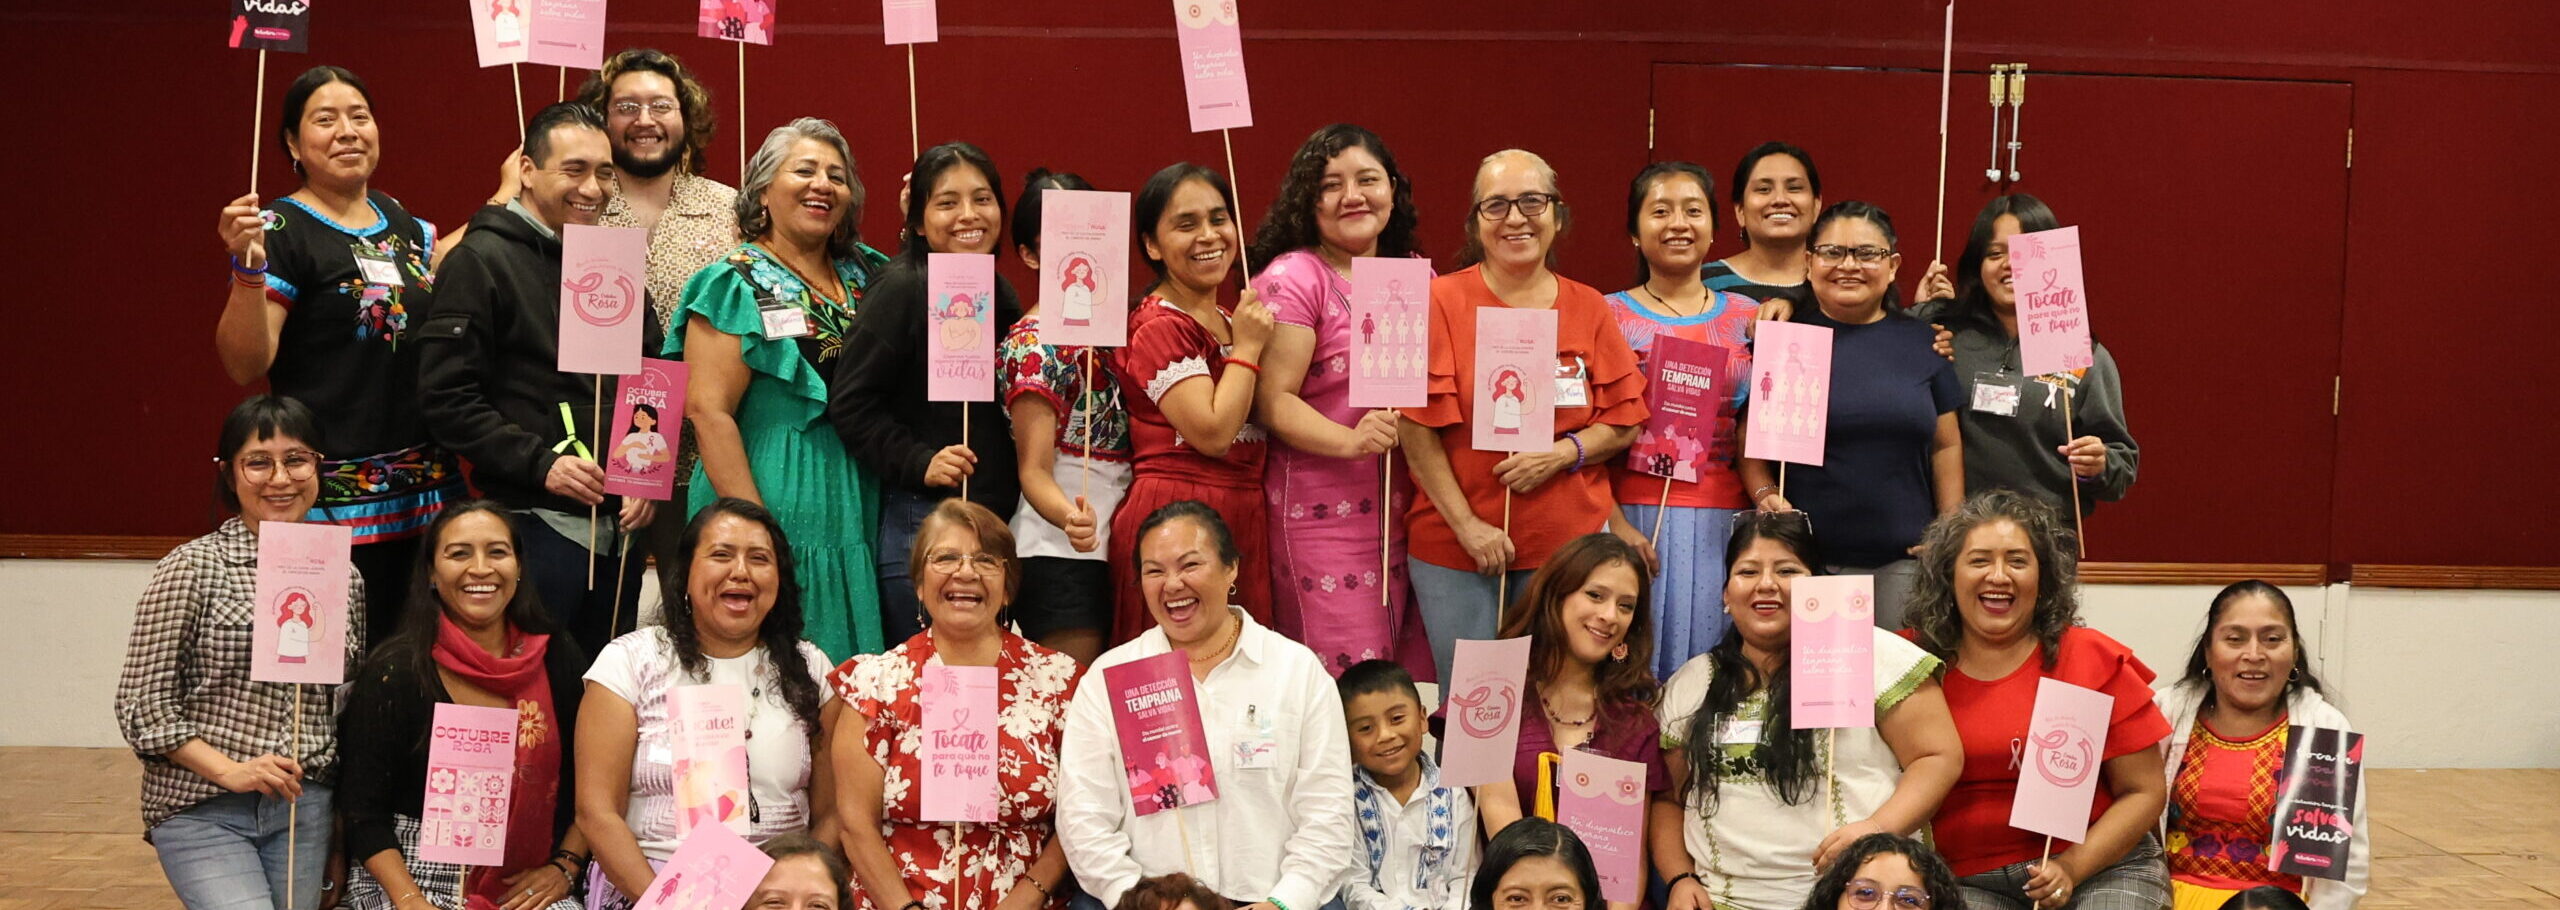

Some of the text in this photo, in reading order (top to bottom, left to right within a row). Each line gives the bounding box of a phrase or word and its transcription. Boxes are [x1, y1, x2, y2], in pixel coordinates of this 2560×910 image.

[244, 0, 307, 15] vidas
[588, 293, 618, 310] Rosa
[2025, 287, 2077, 310] Tocate
[2028, 306, 2081, 321] para que no
[2030, 317, 2081, 335] te toque
[936, 360, 986, 381] vidas
[1664, 360, 1712, 377] UNA DETECCIÓN
[1661, 368, 1711, 390] TEMPRANA
[627, 387, 668, 398] OCTUBRE
[1667, 383, 1701, 397] SALVA VIDAS
[625, 393, 667, 409] ROSA
[1124, 677, 1178, 699] UNA DETECCIÓN
[1124, 687, 1183, 713] TEMPRANA
[1137, 703, 1176, 720] SALVA VIDAS
[1474, 706, 1501, 722] Rosa
[434, 726, 511, 743] OCTUBRE
[932, 729, 988, 752] Tocate
[452, 740, 493, 754] ROSA
[932, 753, 991, 762] para que no
[2049, 751, 2078, 771] Rosa
[933, 762, 989, 779] te toque
[2286, 825, 2349, 844] vidas
